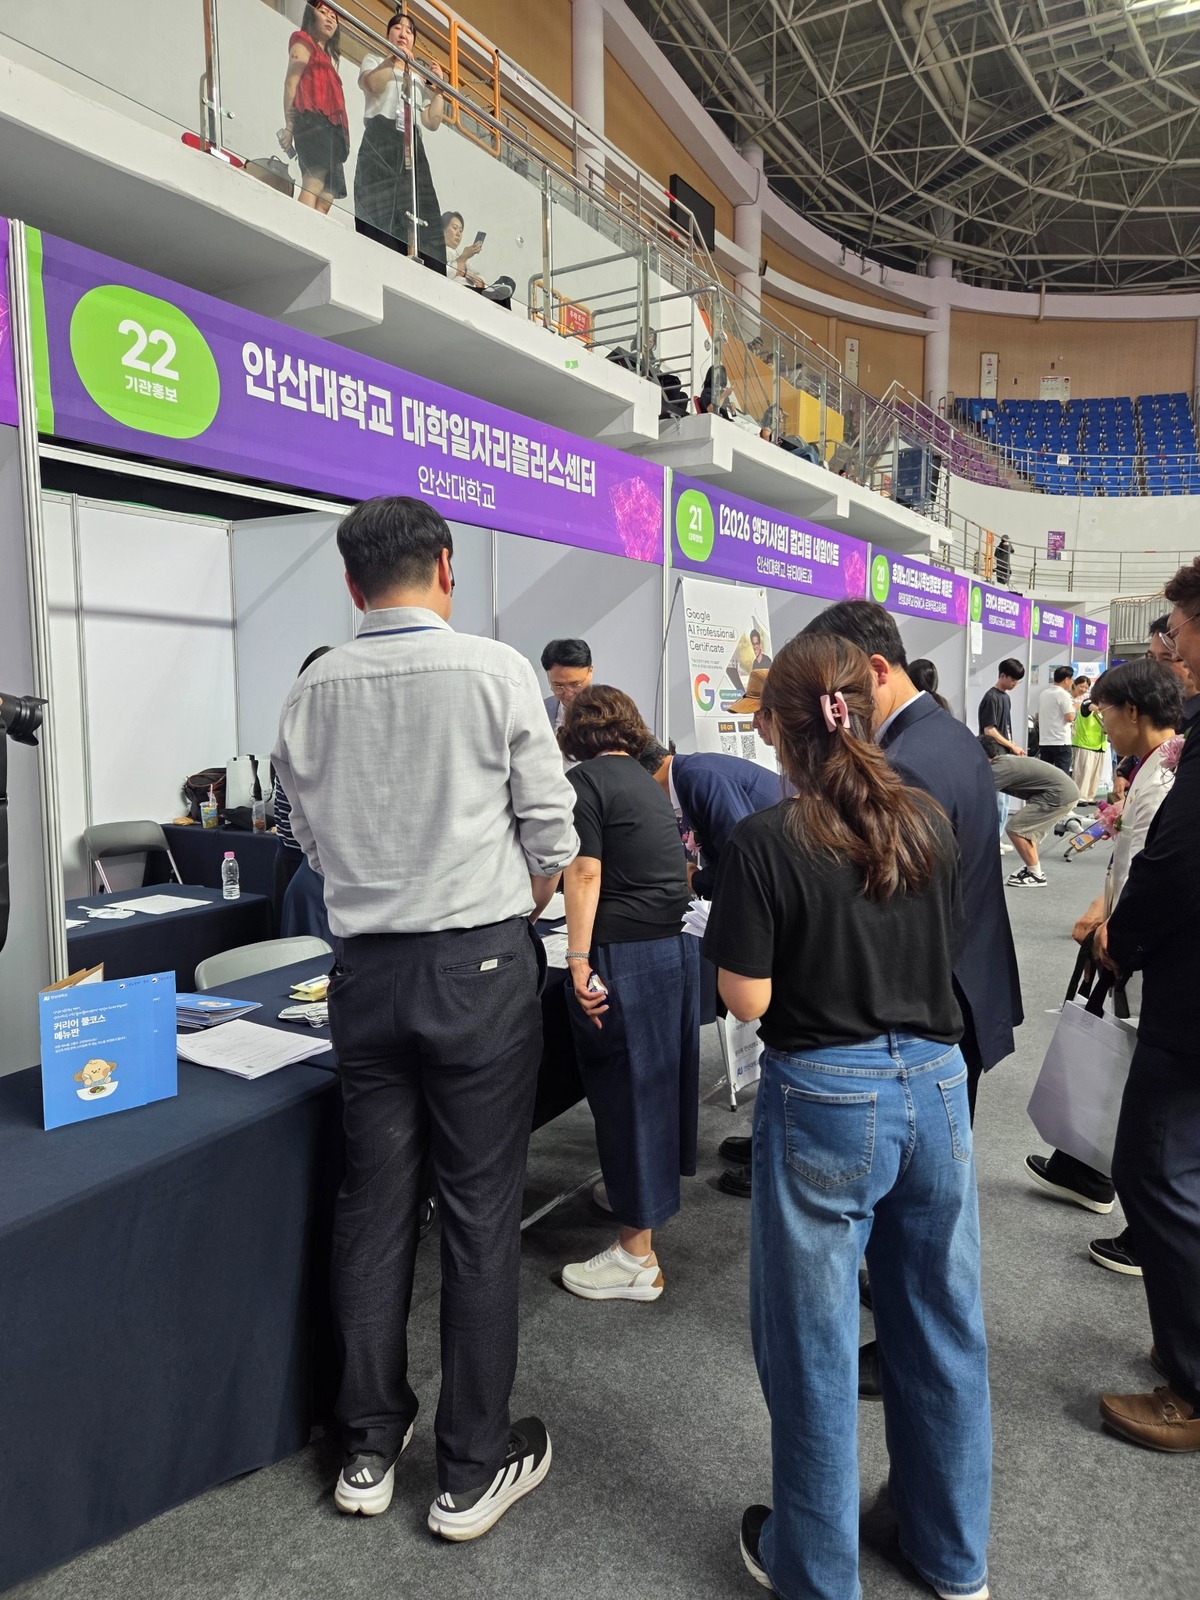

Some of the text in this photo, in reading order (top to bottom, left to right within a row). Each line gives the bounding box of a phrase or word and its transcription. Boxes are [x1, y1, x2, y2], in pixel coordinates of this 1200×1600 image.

[118, 318, 180, 382] 22
[124, 373, 178, 403] 기관홍보
[240, 340, 597, 497] 안산대학교 대학일자리플러스센터
[417, 465, 497, 510] 안산대학교
[689, 505, 702, 531] 21
[719, 503, 750, 542] [2026
[752, 516, 789, 553] 앵커사업]
[756, 557, 786, 578] 안산대학교
[877, 565, 884, 582] 20
[686, 607, 711, 623] Google
[688, 624, 736, 639] AI Professional
[689, 640, 725, 655] Certificate
[53, 1019, 79, 1031] 커리어
[53, 1028, 80, 1041] 메뉴판
